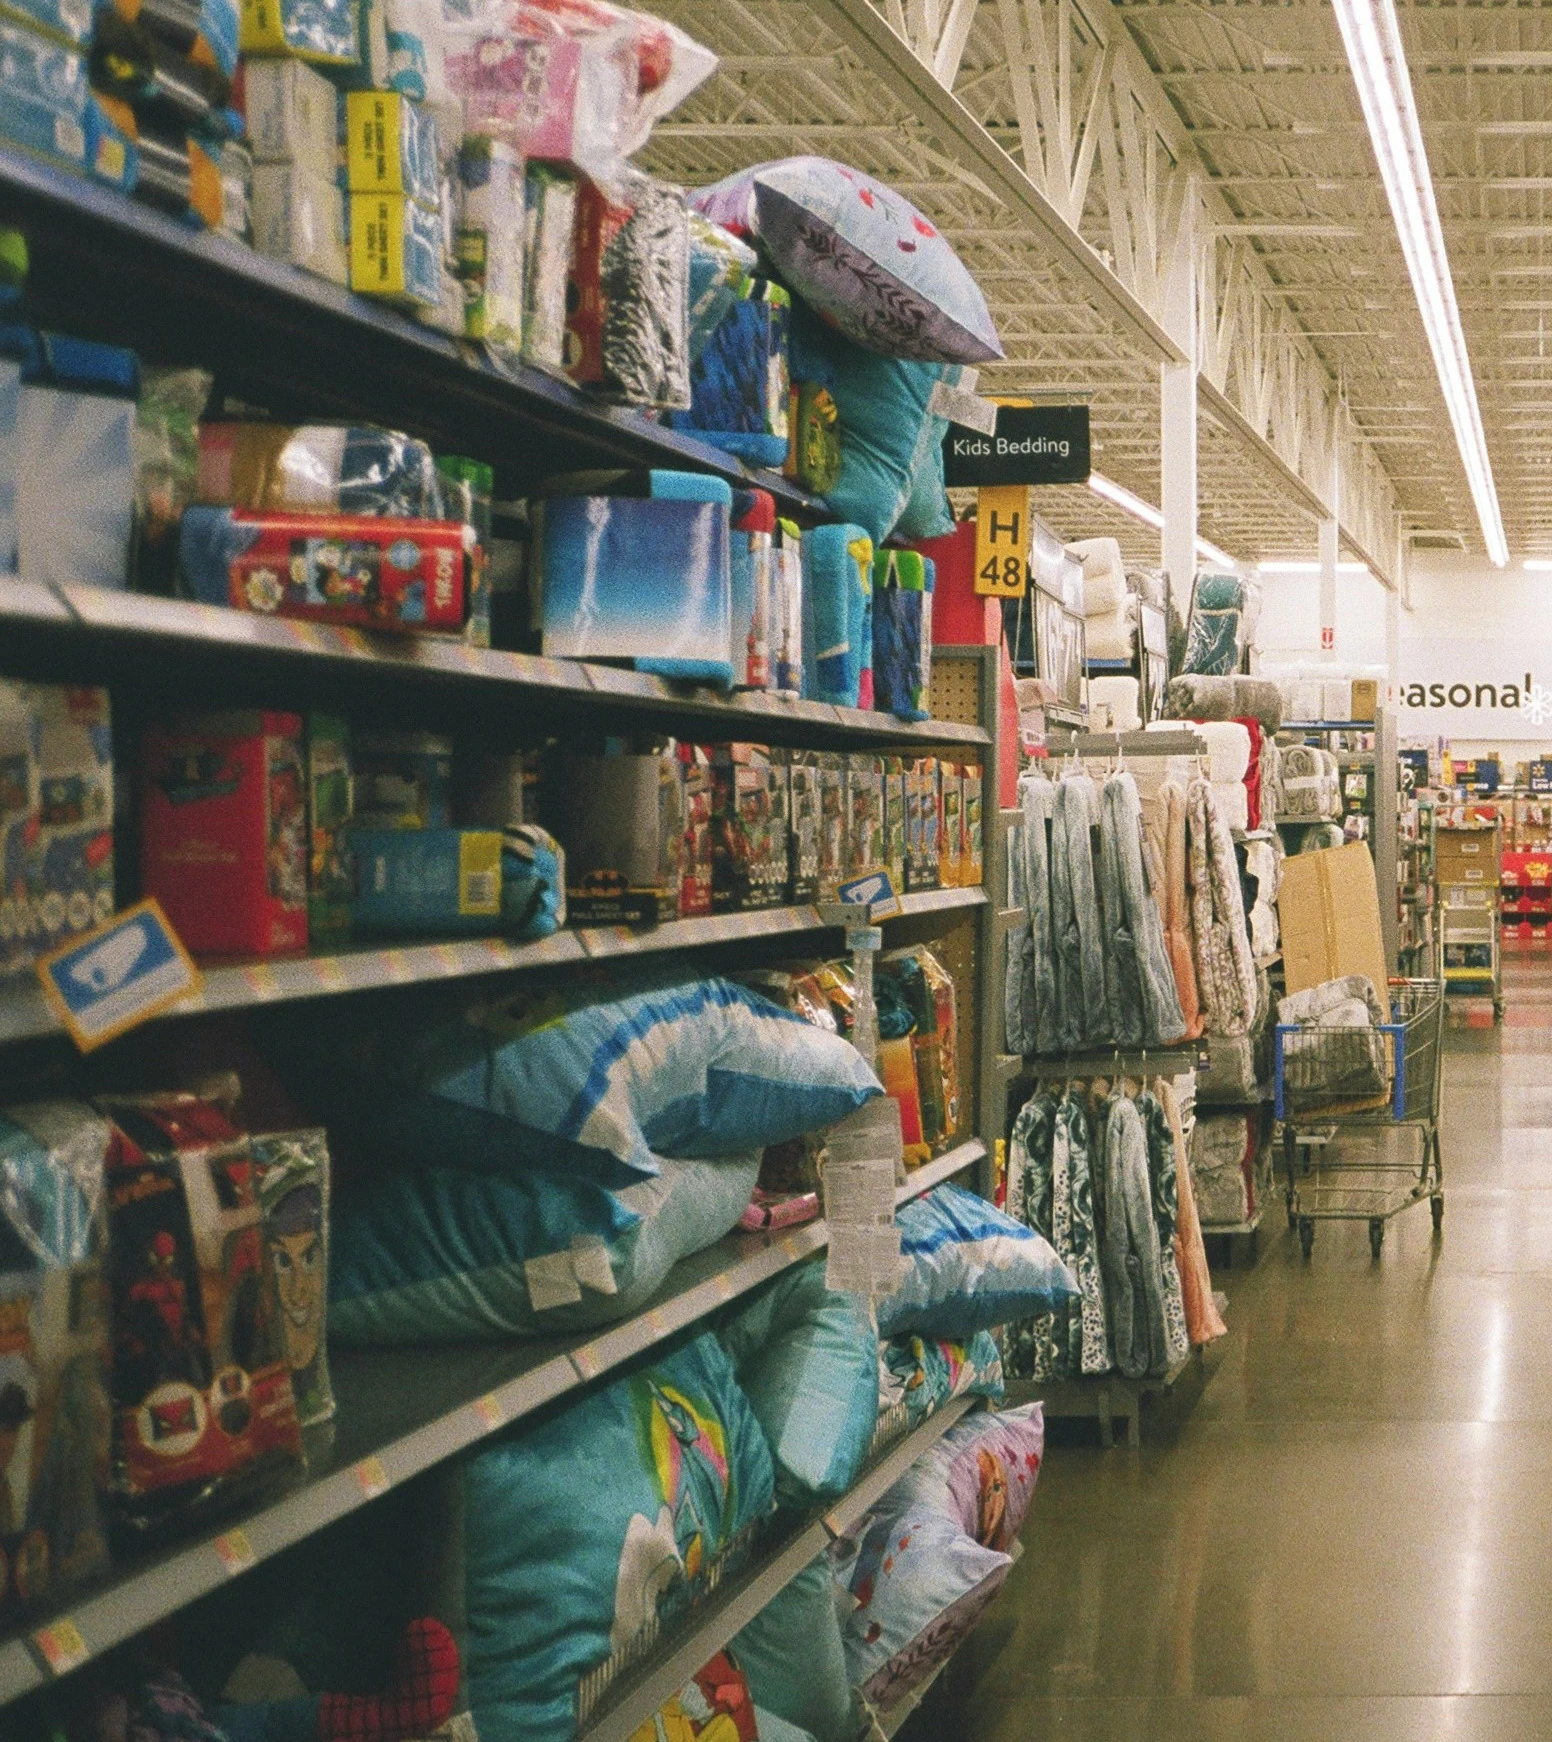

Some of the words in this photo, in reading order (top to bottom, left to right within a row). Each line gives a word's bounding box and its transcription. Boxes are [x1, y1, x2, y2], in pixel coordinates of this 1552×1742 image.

[953, 438, 991, 456] Kids
[996, 436, 1070, 458] Bedding
[989, 510, 1020, 545] H
[979, 556, 1021, 588] 48
[1399, 672, 1531, 708] asonal
